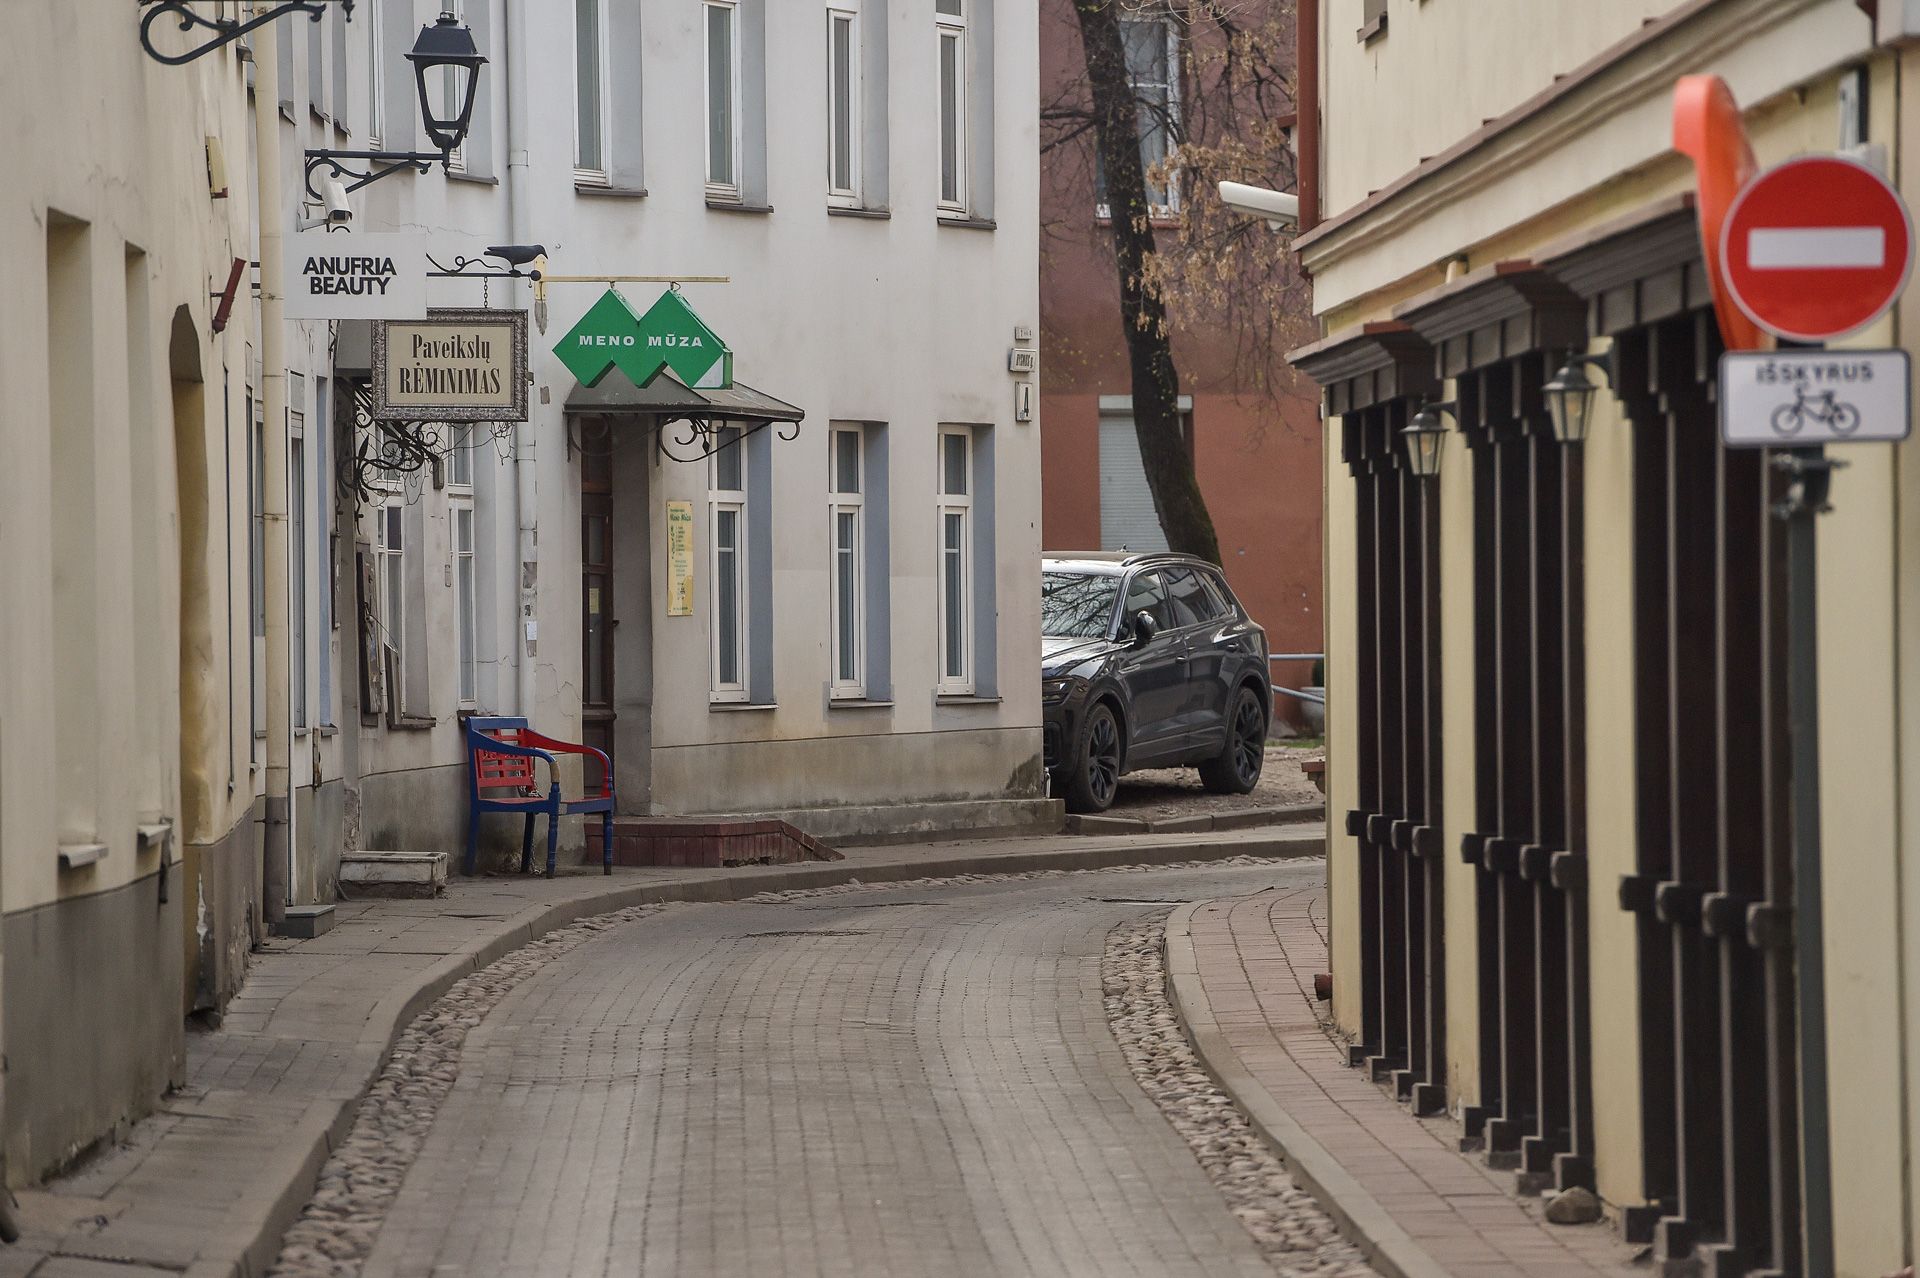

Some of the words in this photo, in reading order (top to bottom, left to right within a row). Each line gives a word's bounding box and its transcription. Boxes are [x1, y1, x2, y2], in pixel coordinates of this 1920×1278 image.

[303, 256, 397, 276] ANUFRIA
[310, 277, 392, 295] BEAUTY
[412, 334, 491, 363] Paveikslų
[579, 335, 636, 346] MENO
[648, 333, 704, 347] MŪZA
[399, 362, 501, 394] RĖMINIMAS
[1756, 358, 1874, 384] IŠSKYRUS
